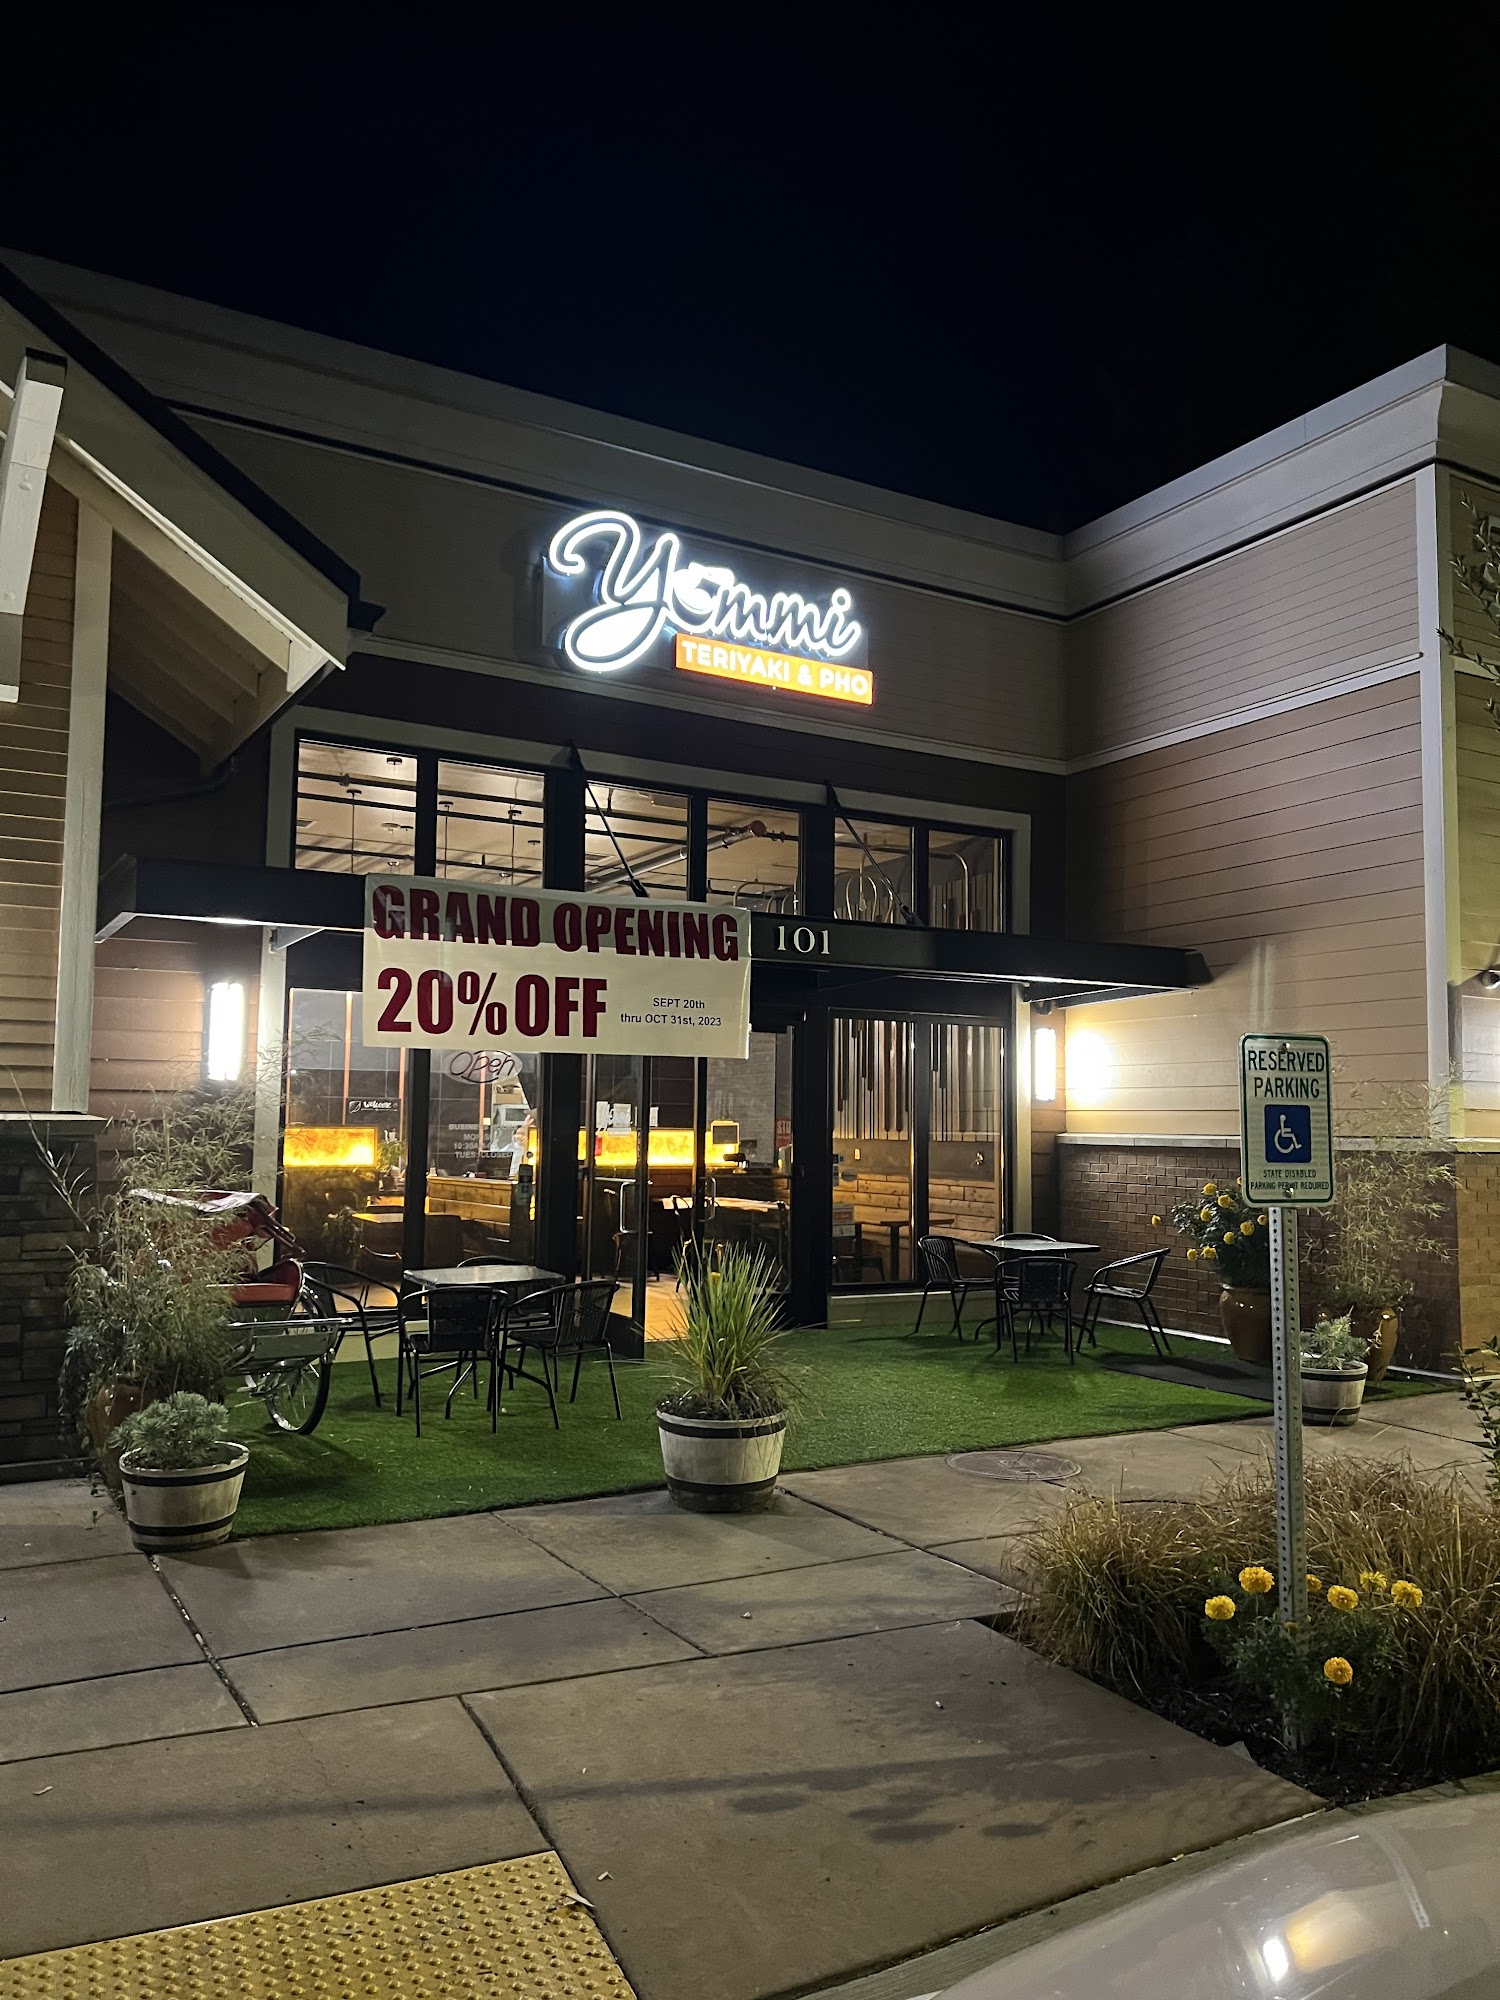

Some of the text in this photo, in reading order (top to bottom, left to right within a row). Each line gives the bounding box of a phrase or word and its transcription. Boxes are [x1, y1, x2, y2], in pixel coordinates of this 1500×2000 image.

[682, 641, 869, 696] TERIYAKI & PHO
[372, 884, 740, 961] GRAND OPENING
[776, 925, 831, 955] 101
[653, 997, 705, 1009] SEPT 20th
[620, 1013, 722, 1027] thru OCT 31st, 2023
[449, 1051, 516, 1079] Open
[1248, 1049, 1325, 1073] RESERVED
[1254, 1076, 1320, 1099] PARKING
[448, 1123, 489, 1131] BUSINES
[777, 1120, 792, 1134] STO
[480, 1151, 513, 1159] CLOSED
[1263, 1169, 1317, 1178] STATE DISABLED
[1250, 1181, 1330, 1190] PARKING PERMIT REQUIRED
